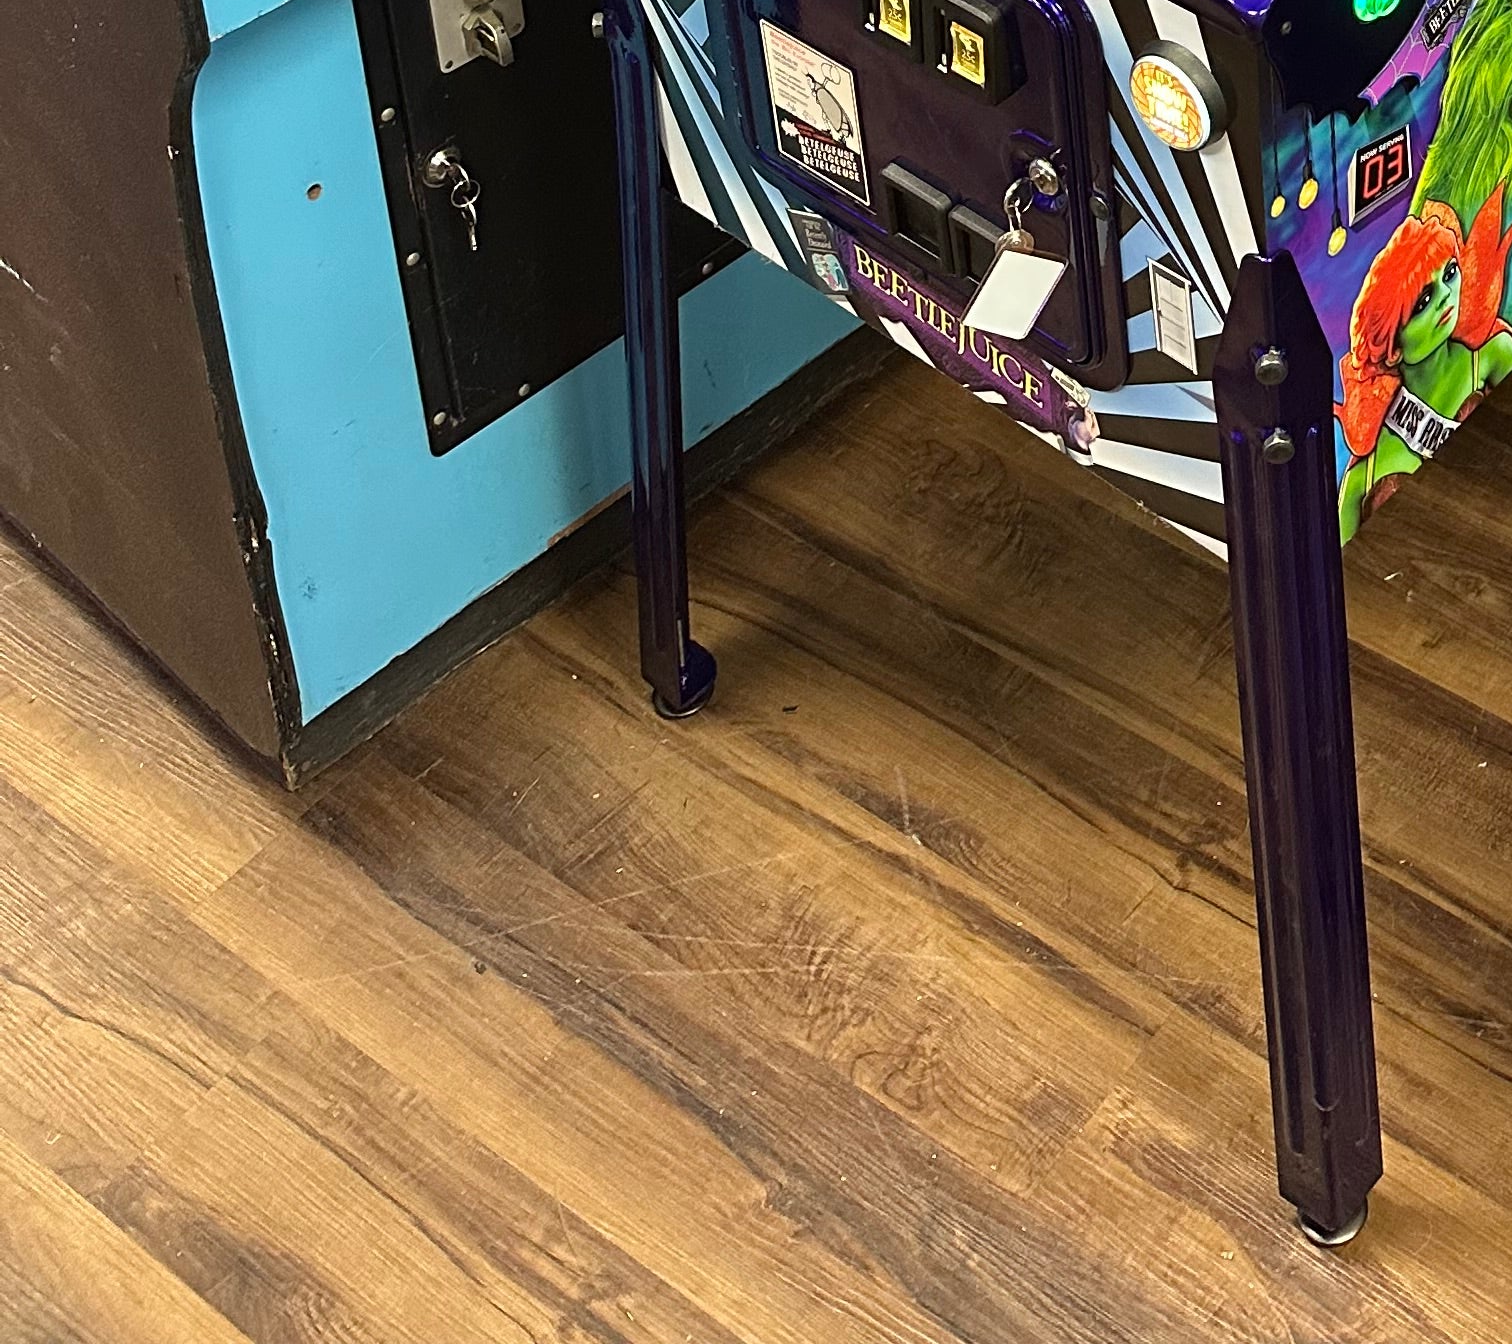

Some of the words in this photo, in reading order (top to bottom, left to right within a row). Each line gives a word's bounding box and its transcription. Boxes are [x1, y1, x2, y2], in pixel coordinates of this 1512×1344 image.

[803, 154, 861, 183] BETELGEUSE
[1359, 146, 1377, 164] NOW
[1362, 143, 1403, 199] 03
[853, 243, 1044, 409] BEETLEJUICE
[1390, 395, 1425, 439] MISS
